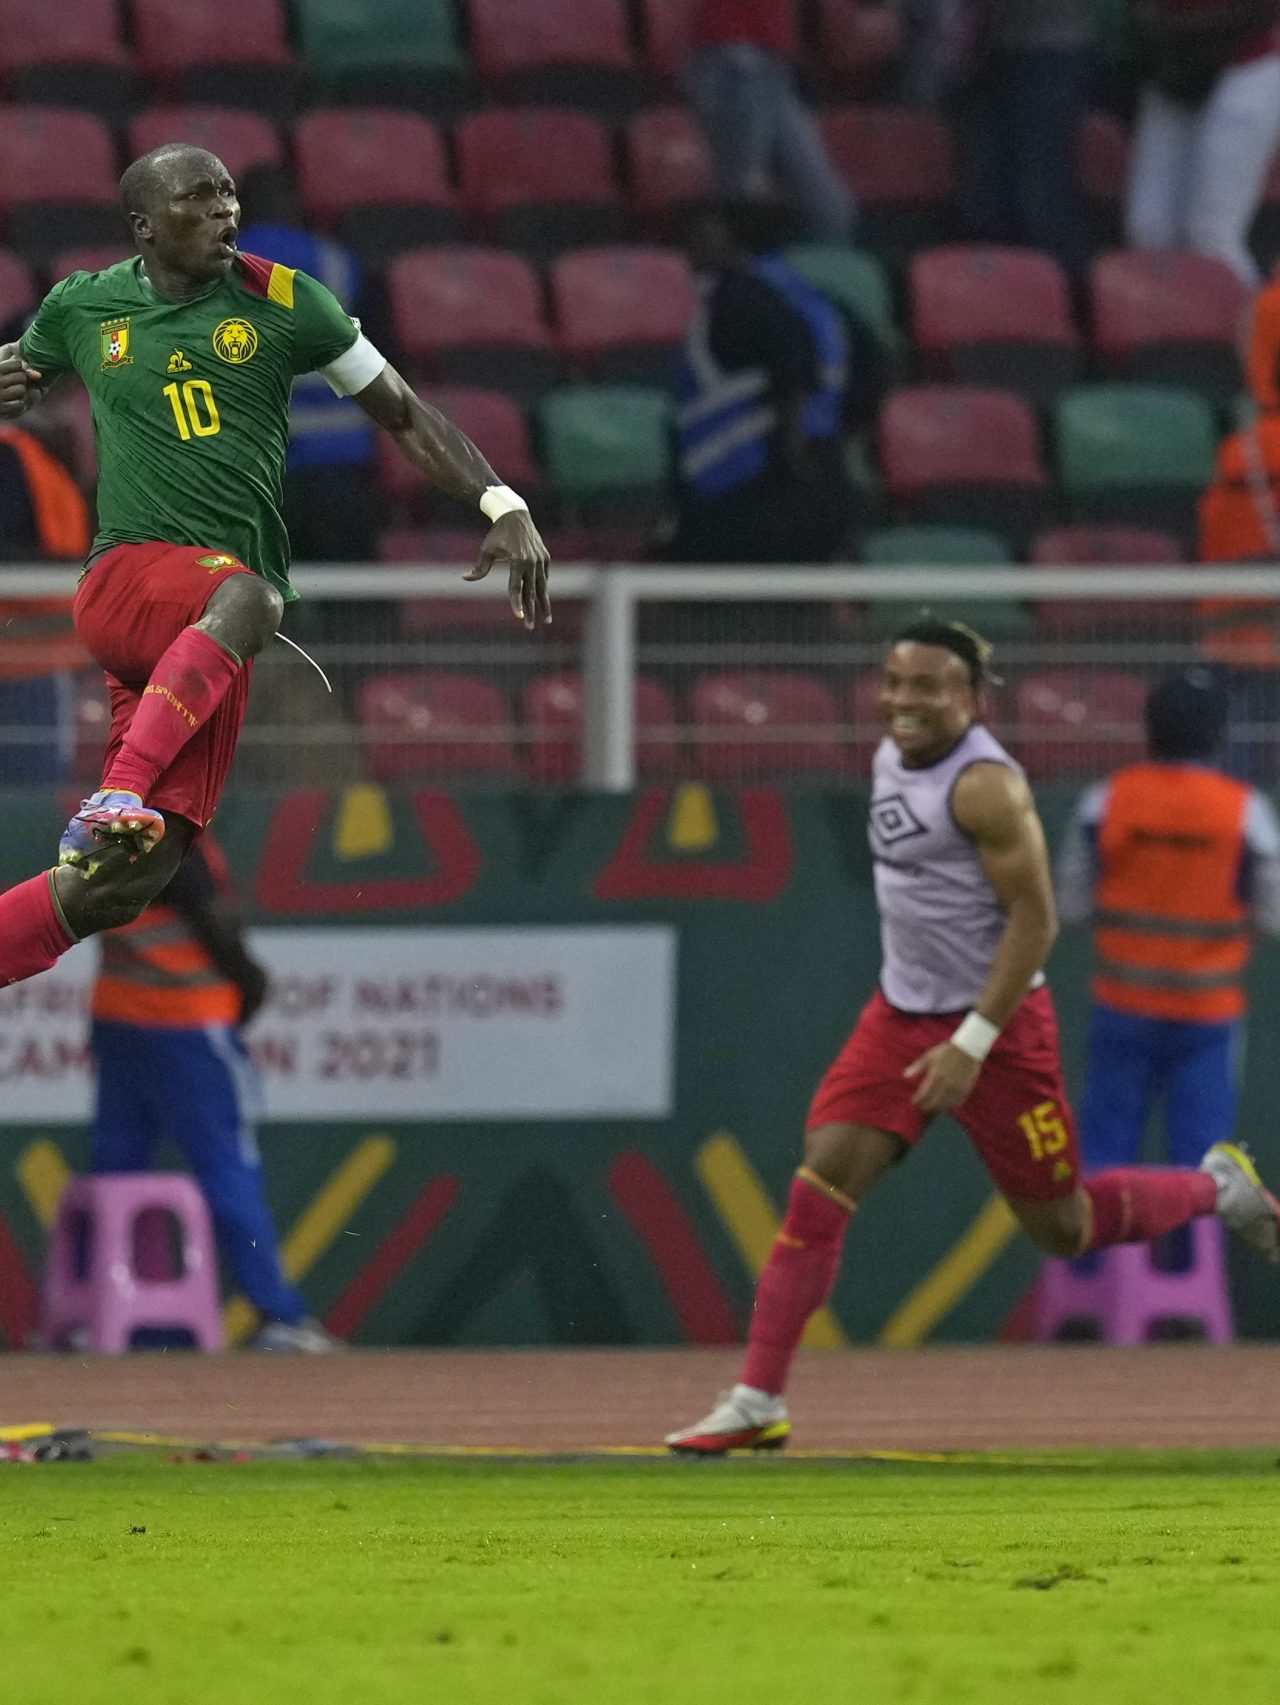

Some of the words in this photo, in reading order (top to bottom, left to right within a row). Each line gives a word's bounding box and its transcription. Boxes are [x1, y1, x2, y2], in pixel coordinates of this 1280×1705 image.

[163, 380, 220, 441] 10
[356, 974, 564, 1017] NATIONS
[321, 1029, 441, 1080] 2021
[1019, 1101, 1068, 1160] 15
